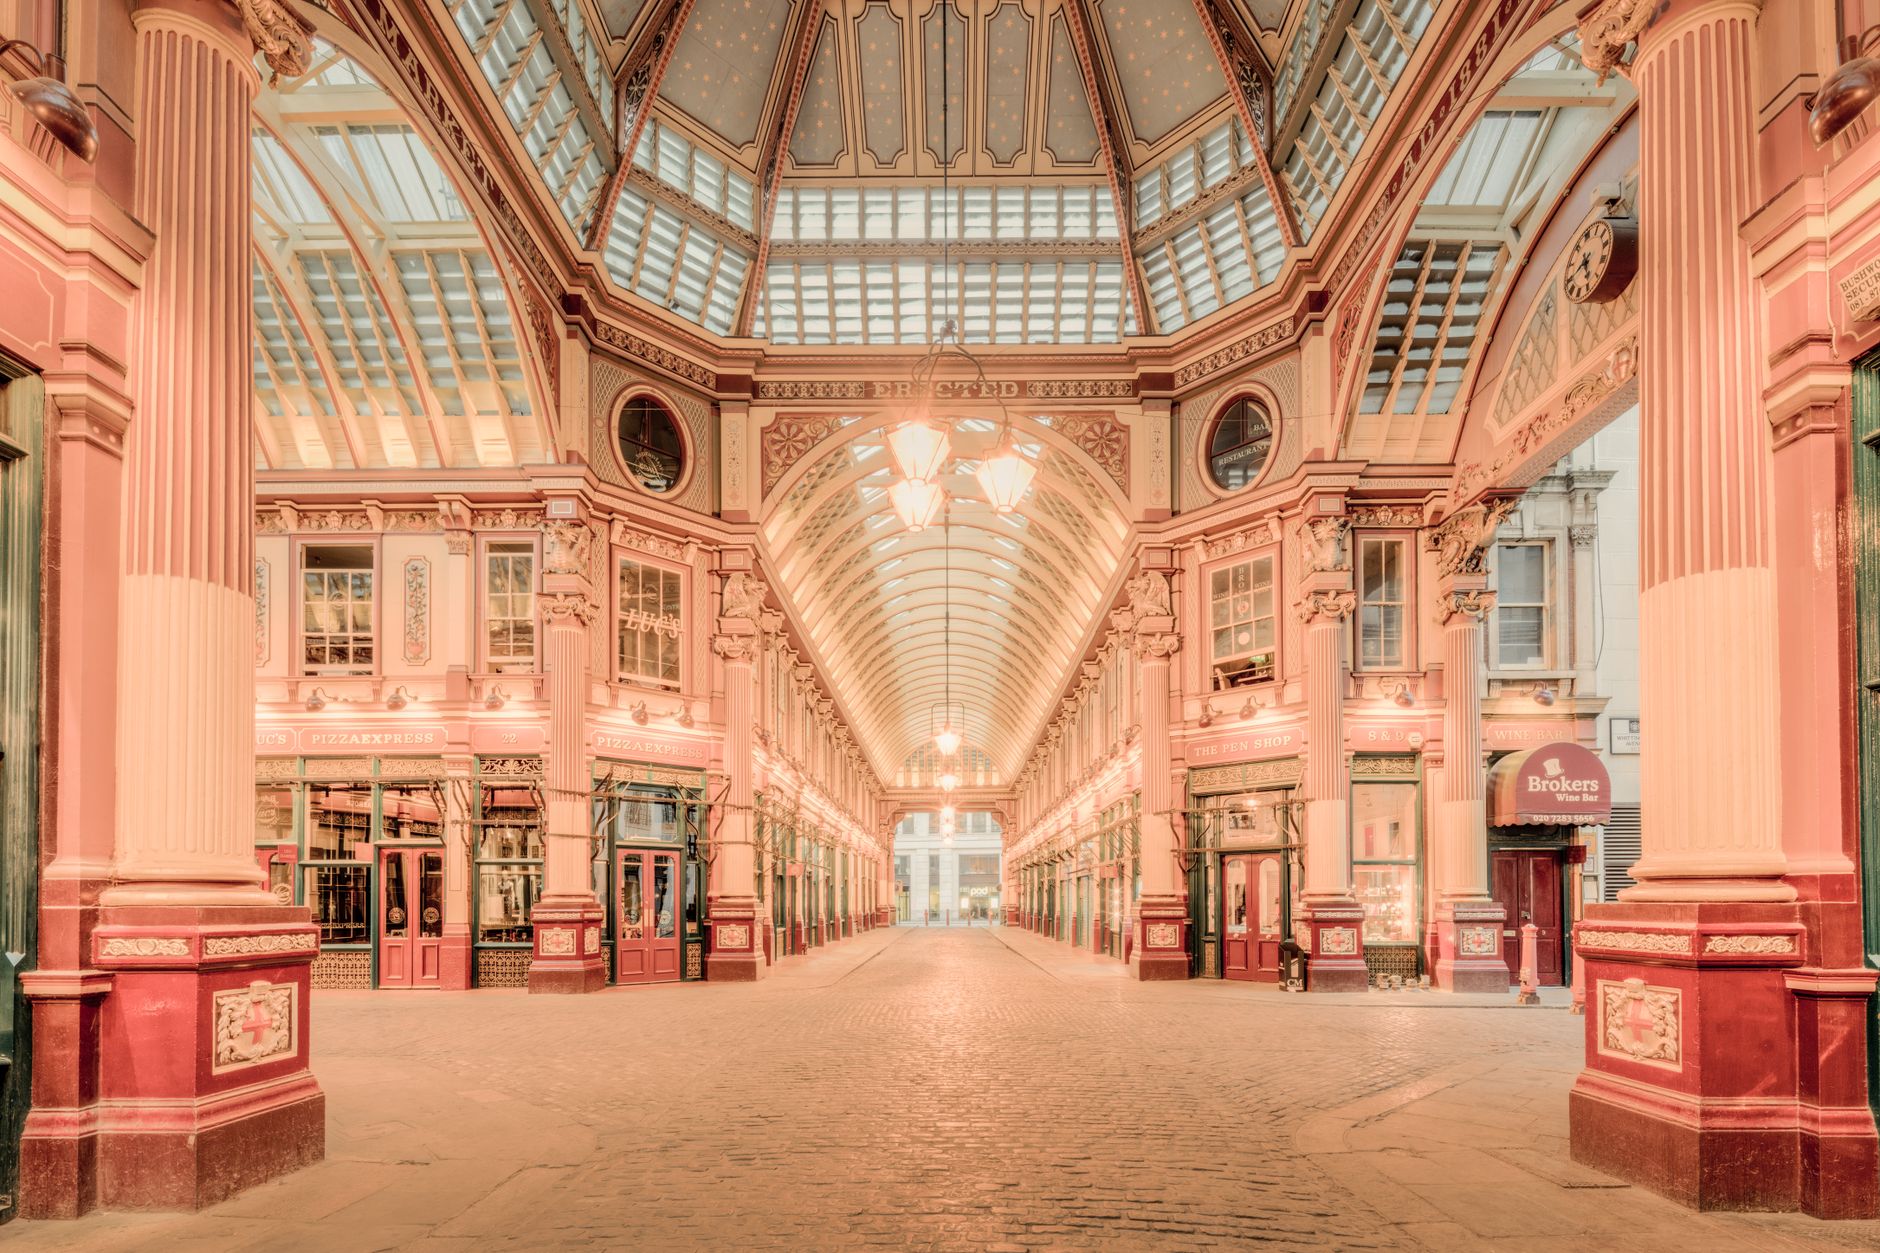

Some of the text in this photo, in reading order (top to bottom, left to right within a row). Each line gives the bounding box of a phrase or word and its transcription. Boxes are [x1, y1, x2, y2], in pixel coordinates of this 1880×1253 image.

[1448, 14, 1506, 107] 1881
[376, 8, 498, 197] MARKET
[1850, 297, 1864, 312] 081
[1218, 445, 1267, 465] RESTAURANT
[1238, 567, 1246, 618] BROS
[624, 608, 682, 639] LUC'S
[256, 733, 287, 745] UC'S
[312, 733, 434, 745] PIZZAEXPRESS
[502, 733, 517, 744] 22
[1368, 730, 1377, 741] 8
[1381, 730, 1391, 741] &
[1395, 731, 1405, 742] 9
[1494, 730, 1563, 740] WINE BAR
[597, 736, 704, 759] PIZZAEXPRESS
[1194, 735, 1293, 757] THE PEN SHOP
[1528, 776, 1599, 791] Brokers
[1555, 793, 1599, 802] Wine Bar
[1533, 814, 1596, 823] 020 7283 5656
[971, 886, 988, 897] pod
[1287, 979, 1303, 987] CM
